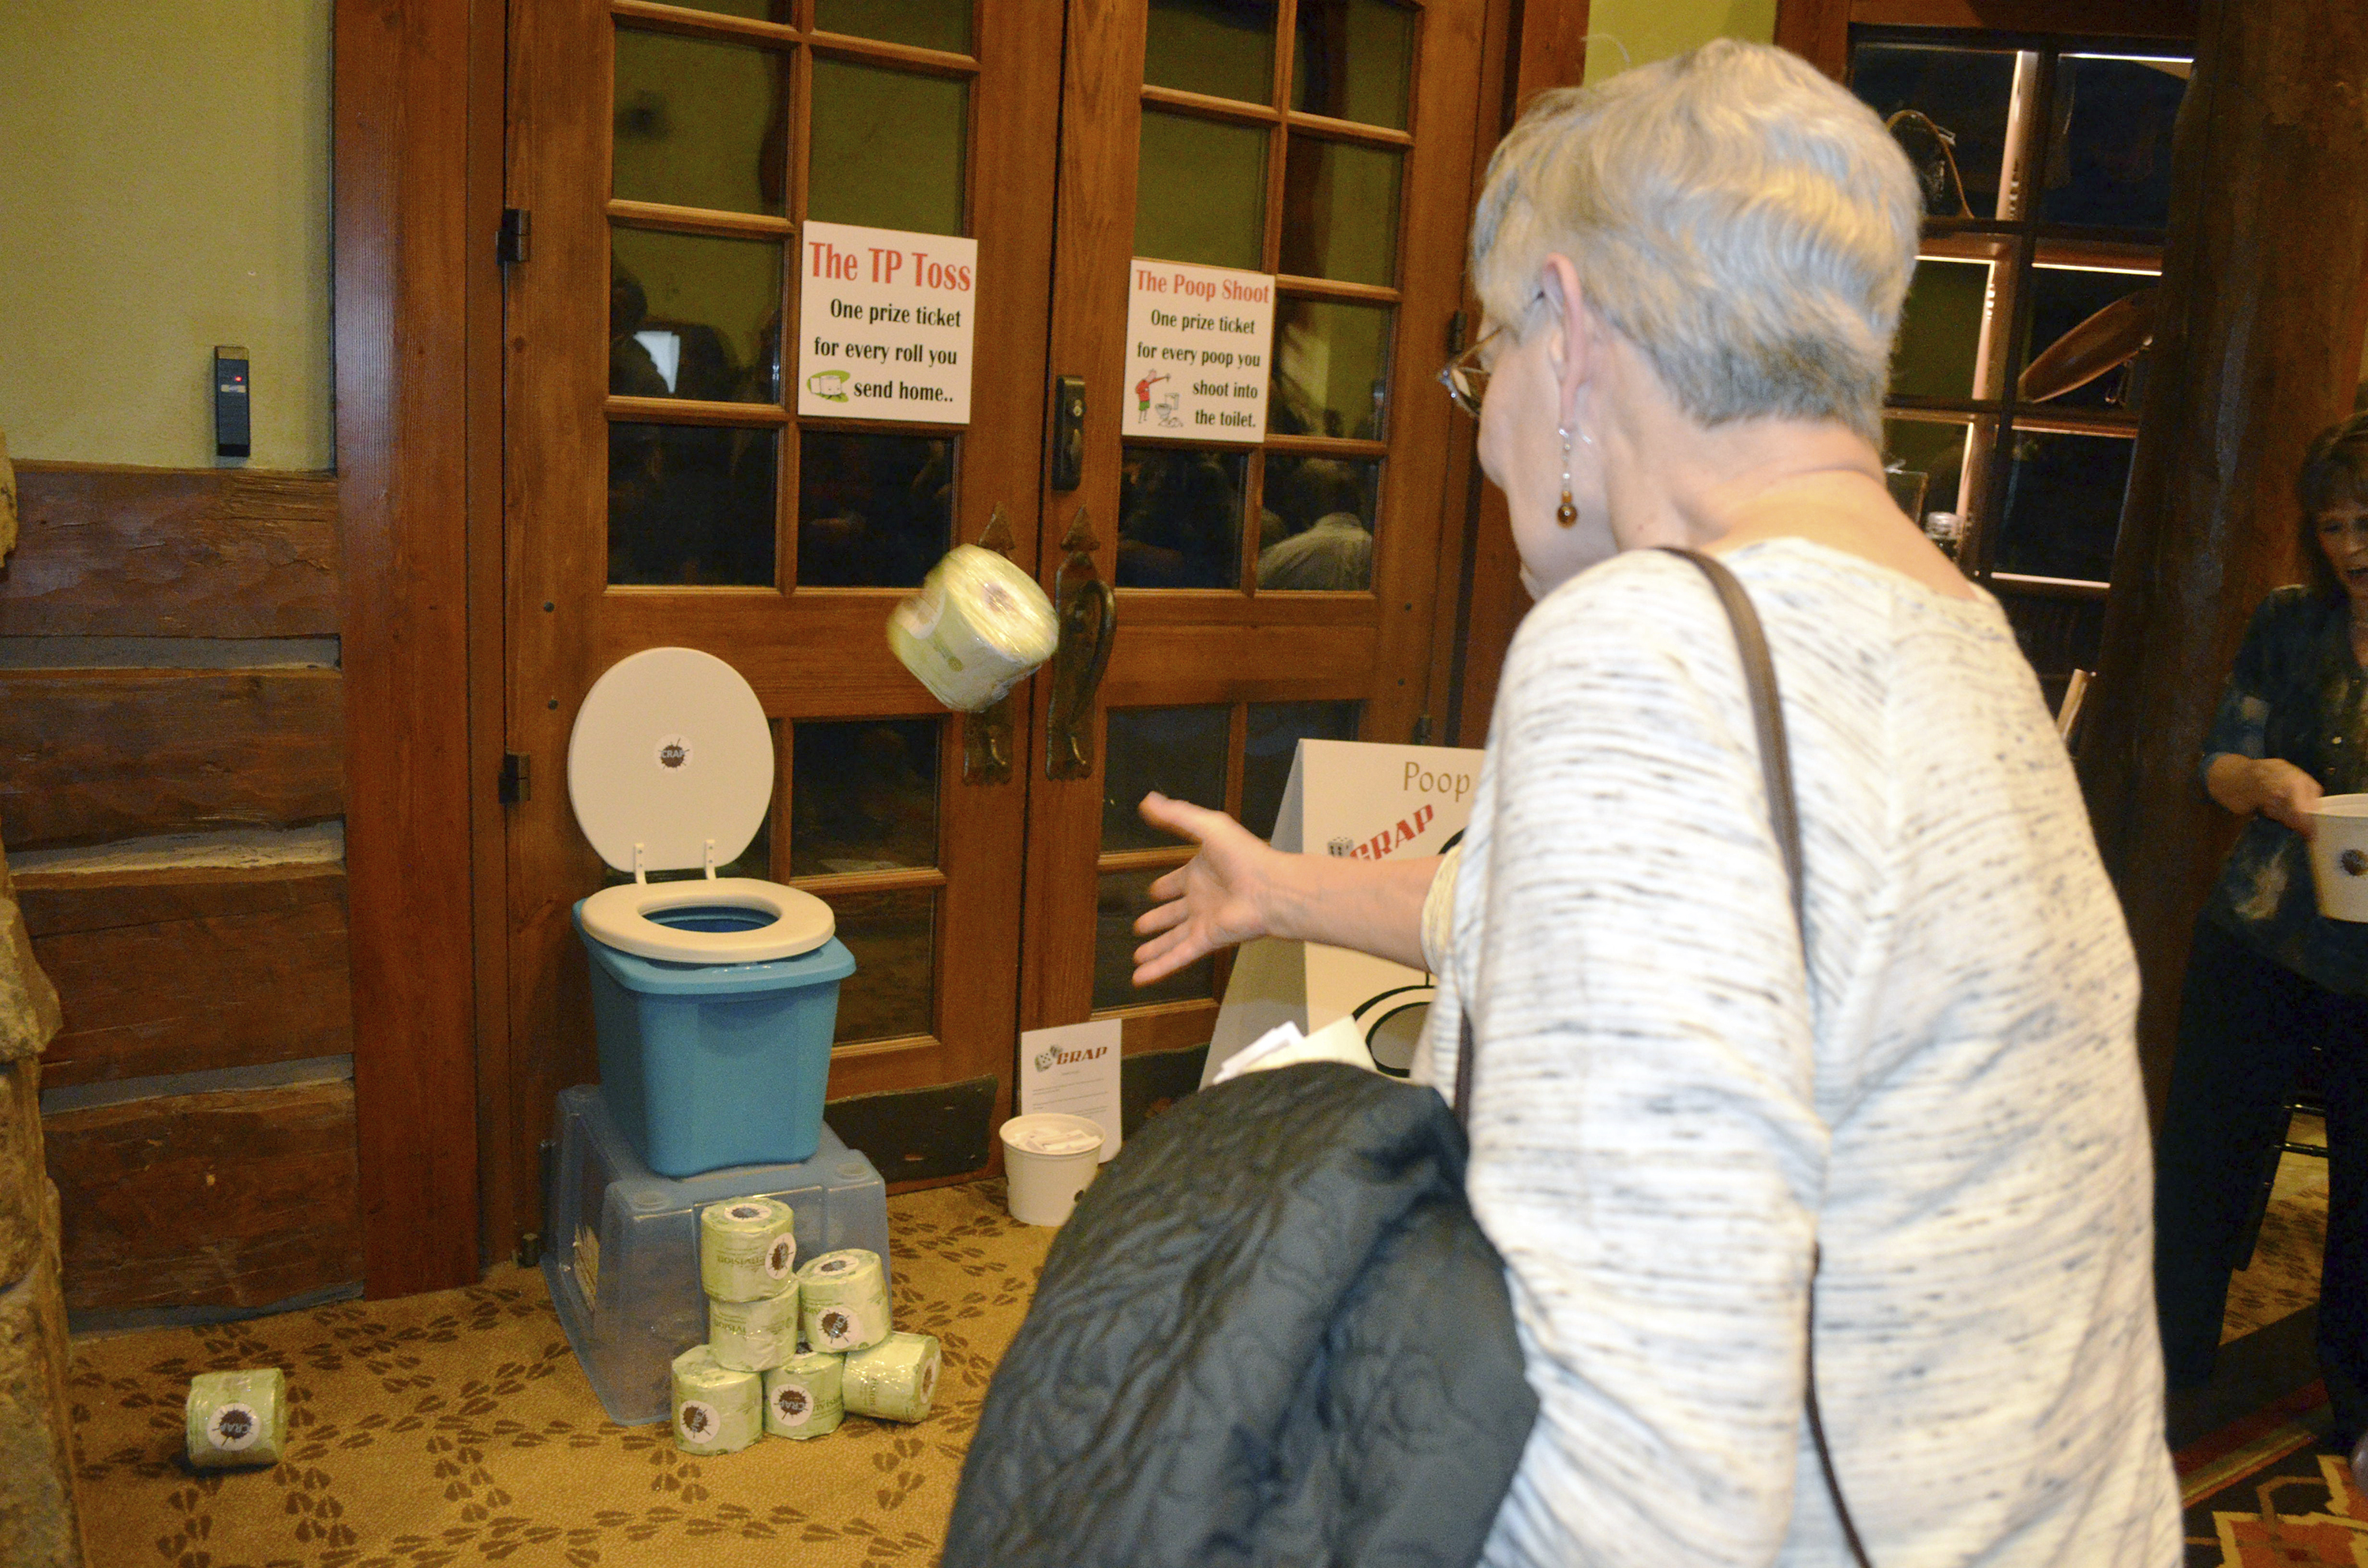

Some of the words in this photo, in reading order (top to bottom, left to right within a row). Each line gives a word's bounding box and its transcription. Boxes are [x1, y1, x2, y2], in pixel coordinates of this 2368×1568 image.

[808, 241, 858, 281] The
[868, 248, 902, 284] TP
[912, 253, 971, 292] Toss
[1137, 269, 1167, 294] The
[1174, 274, 1216, 302] Poop
[1222, 279, 1270, 304] Shoot
[830, 298, 863, 320] One
[869, 303, 910, 324] prize
[916, 306, 961, 327] ticket
[1151, 309, 1177, 327] One
[1182, 313, 1215, 332] prize
[1220, 316, 1255, 335] ticket
[814, 336, 839, 356] for
[845, 342, 890, 364] every
[895, 344, 923, 362] roll
[928, 349, 957, 368] you
[1137, 341, 1157, 358] for
[1162, 347, 1197, 365] every
[1201, 350, 1234, 368] poop
[1238, 354, 1261, 369] you
[853, 380, 893, 399] send
[1193, 380, 1229, 397] shoot
[1234, 382, 1258, 399] into
[1195, 410, 1215, 425] the
[1220, 410, 1256, 428] toilet.
[661, 749, 685, 759] CRAP
[1404, 761, 1470, 803] Poop
[779, 1399, 805, 1411] CRAP
